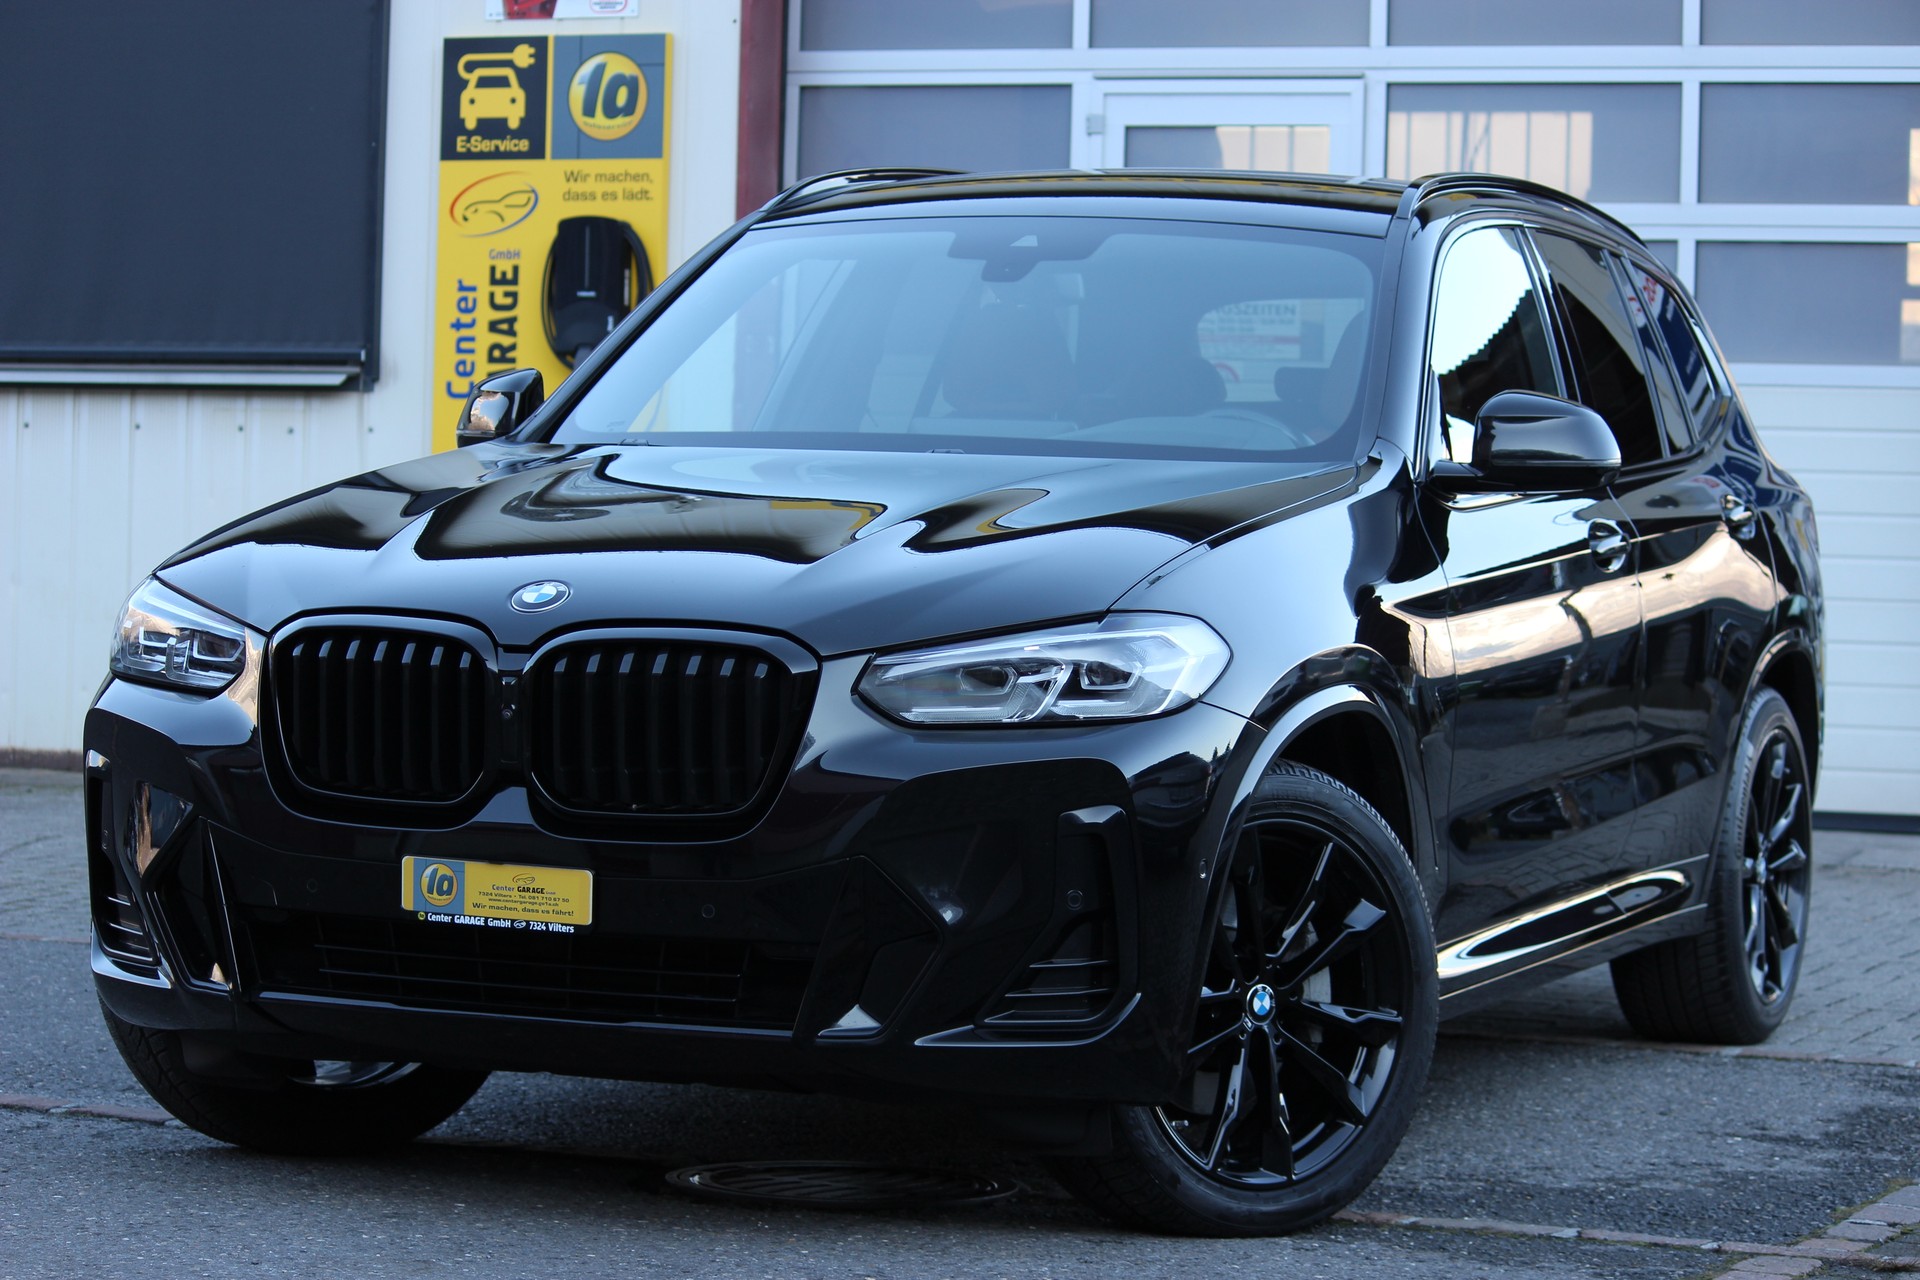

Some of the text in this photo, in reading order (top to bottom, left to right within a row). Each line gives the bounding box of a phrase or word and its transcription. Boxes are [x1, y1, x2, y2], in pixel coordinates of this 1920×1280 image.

[577, 60, 640, 120] 1a
[456, 135, 530, 153] E-Service
[563, 169, 654, 184] Wir machen,
[562, 187, 654, 201] dass es lädt.
[488, 249, 521, 260] GmbH
[487, 264, 519, 377] RAGE
[446, 279, 478, 399] Center
[425, 867, 454, 897] 1a
[491, 884, 515, 892] Center
[517, 886, 545, 894] GARAGE
[521, 906, 540, 914] dass
[427, 912, 453, 923] Center
[454, 914, 486, 926] GARAGE
[487, 917, 511, 928] GmbH
[529, 921, 547, 931] 7324
[548, 923, 575, 933] Vilters
